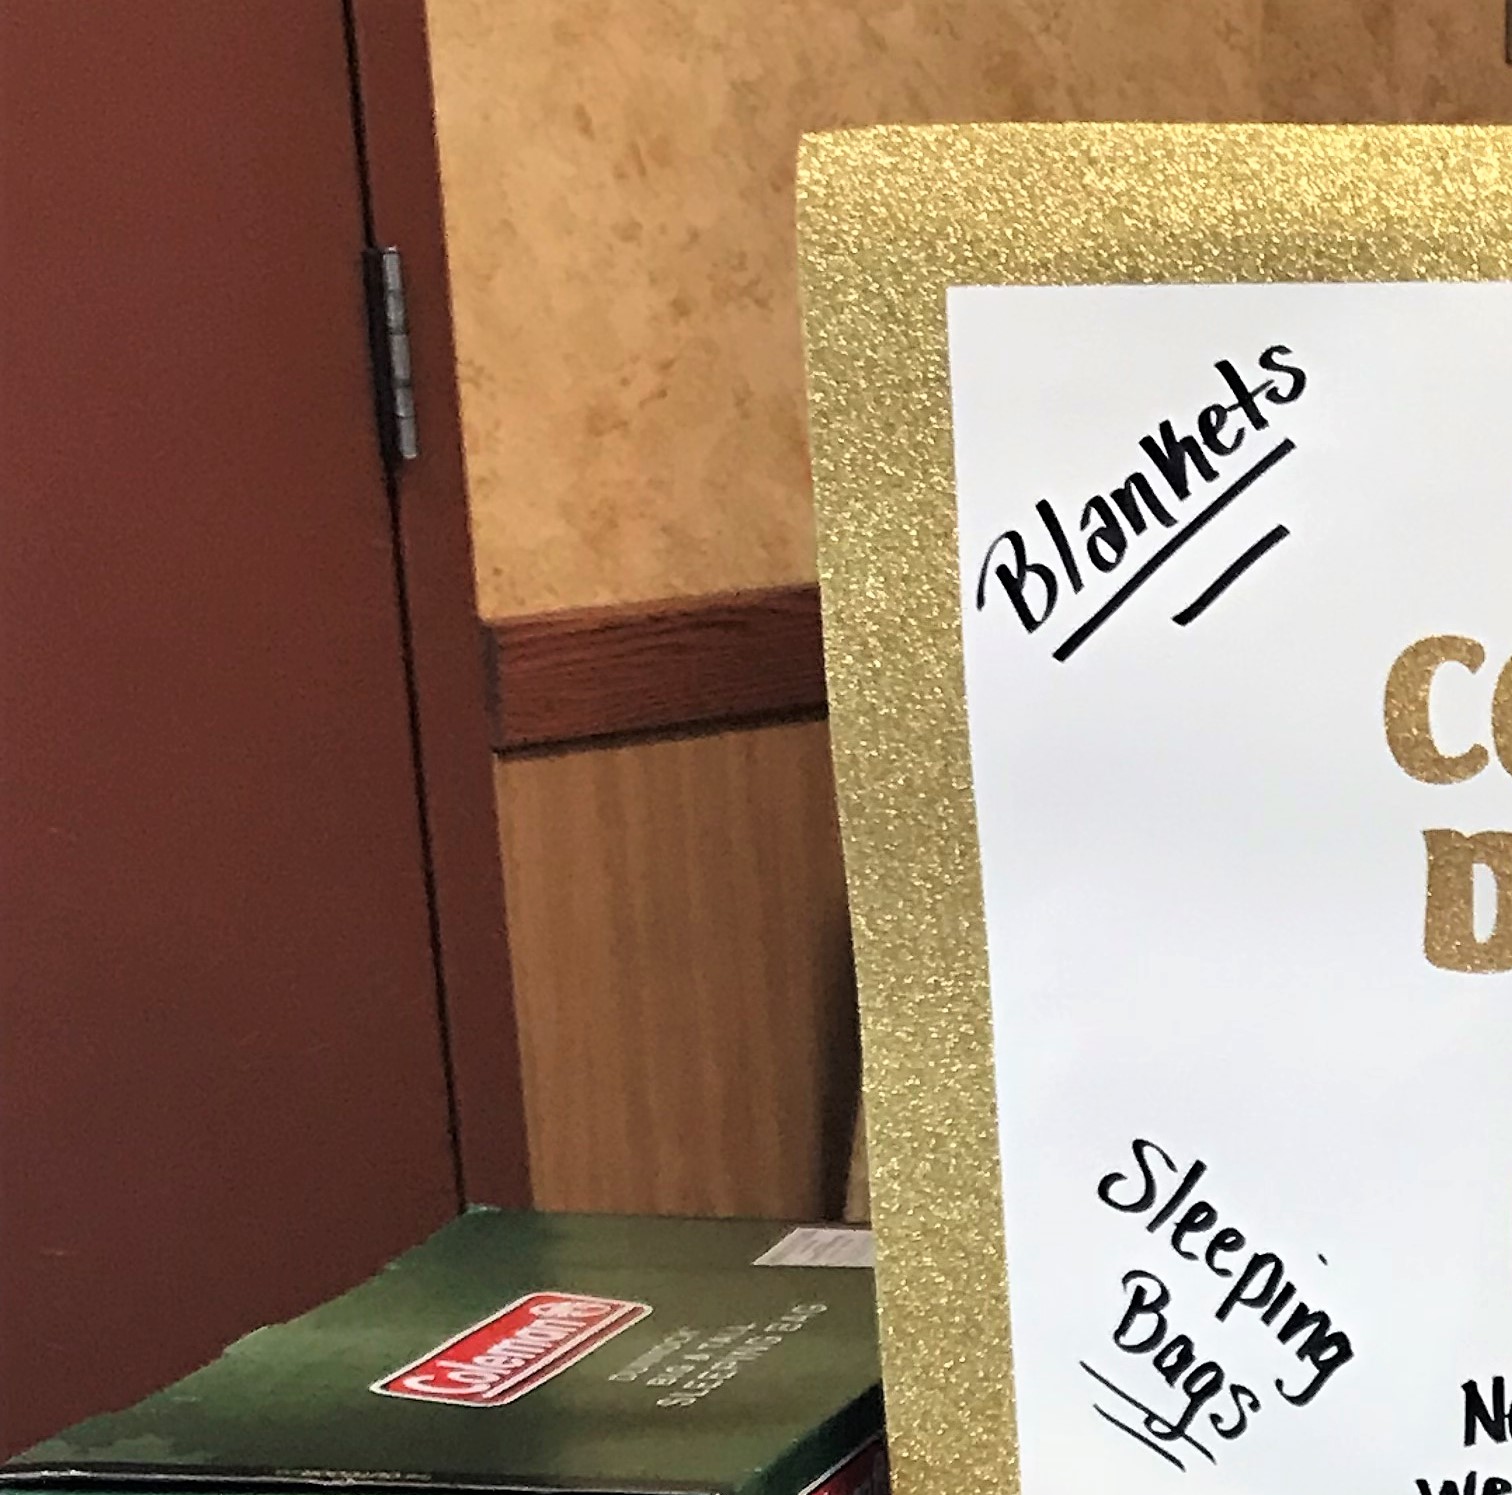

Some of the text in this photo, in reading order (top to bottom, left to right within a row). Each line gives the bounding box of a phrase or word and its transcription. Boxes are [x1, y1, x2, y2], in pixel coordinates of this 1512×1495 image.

[976, 344, 1308, 634] Blankets
[1097, 1137, 1354, 1408] Sleeping
[1113, 1267, 1262, 1443] Bags
